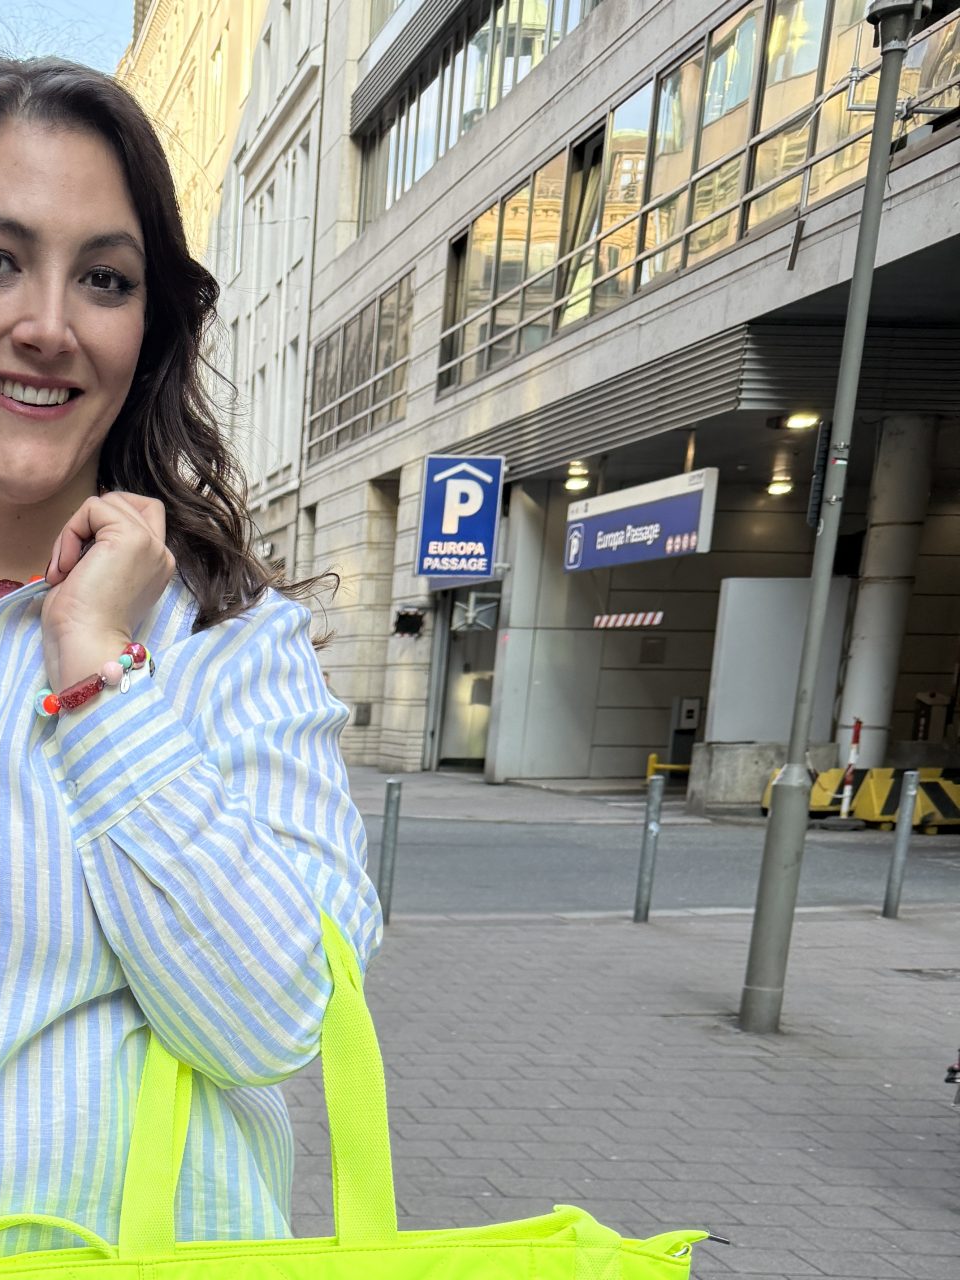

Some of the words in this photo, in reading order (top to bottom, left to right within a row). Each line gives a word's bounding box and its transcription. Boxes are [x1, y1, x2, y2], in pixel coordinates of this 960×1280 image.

[441, 479, 484, 535] P
[596, 530, 625, 551] Europa
[625, 522, 660, 545] Passage
[428, 541, 485, 556] EUROPA
[423, 557, 488, 571] PASSAGE
